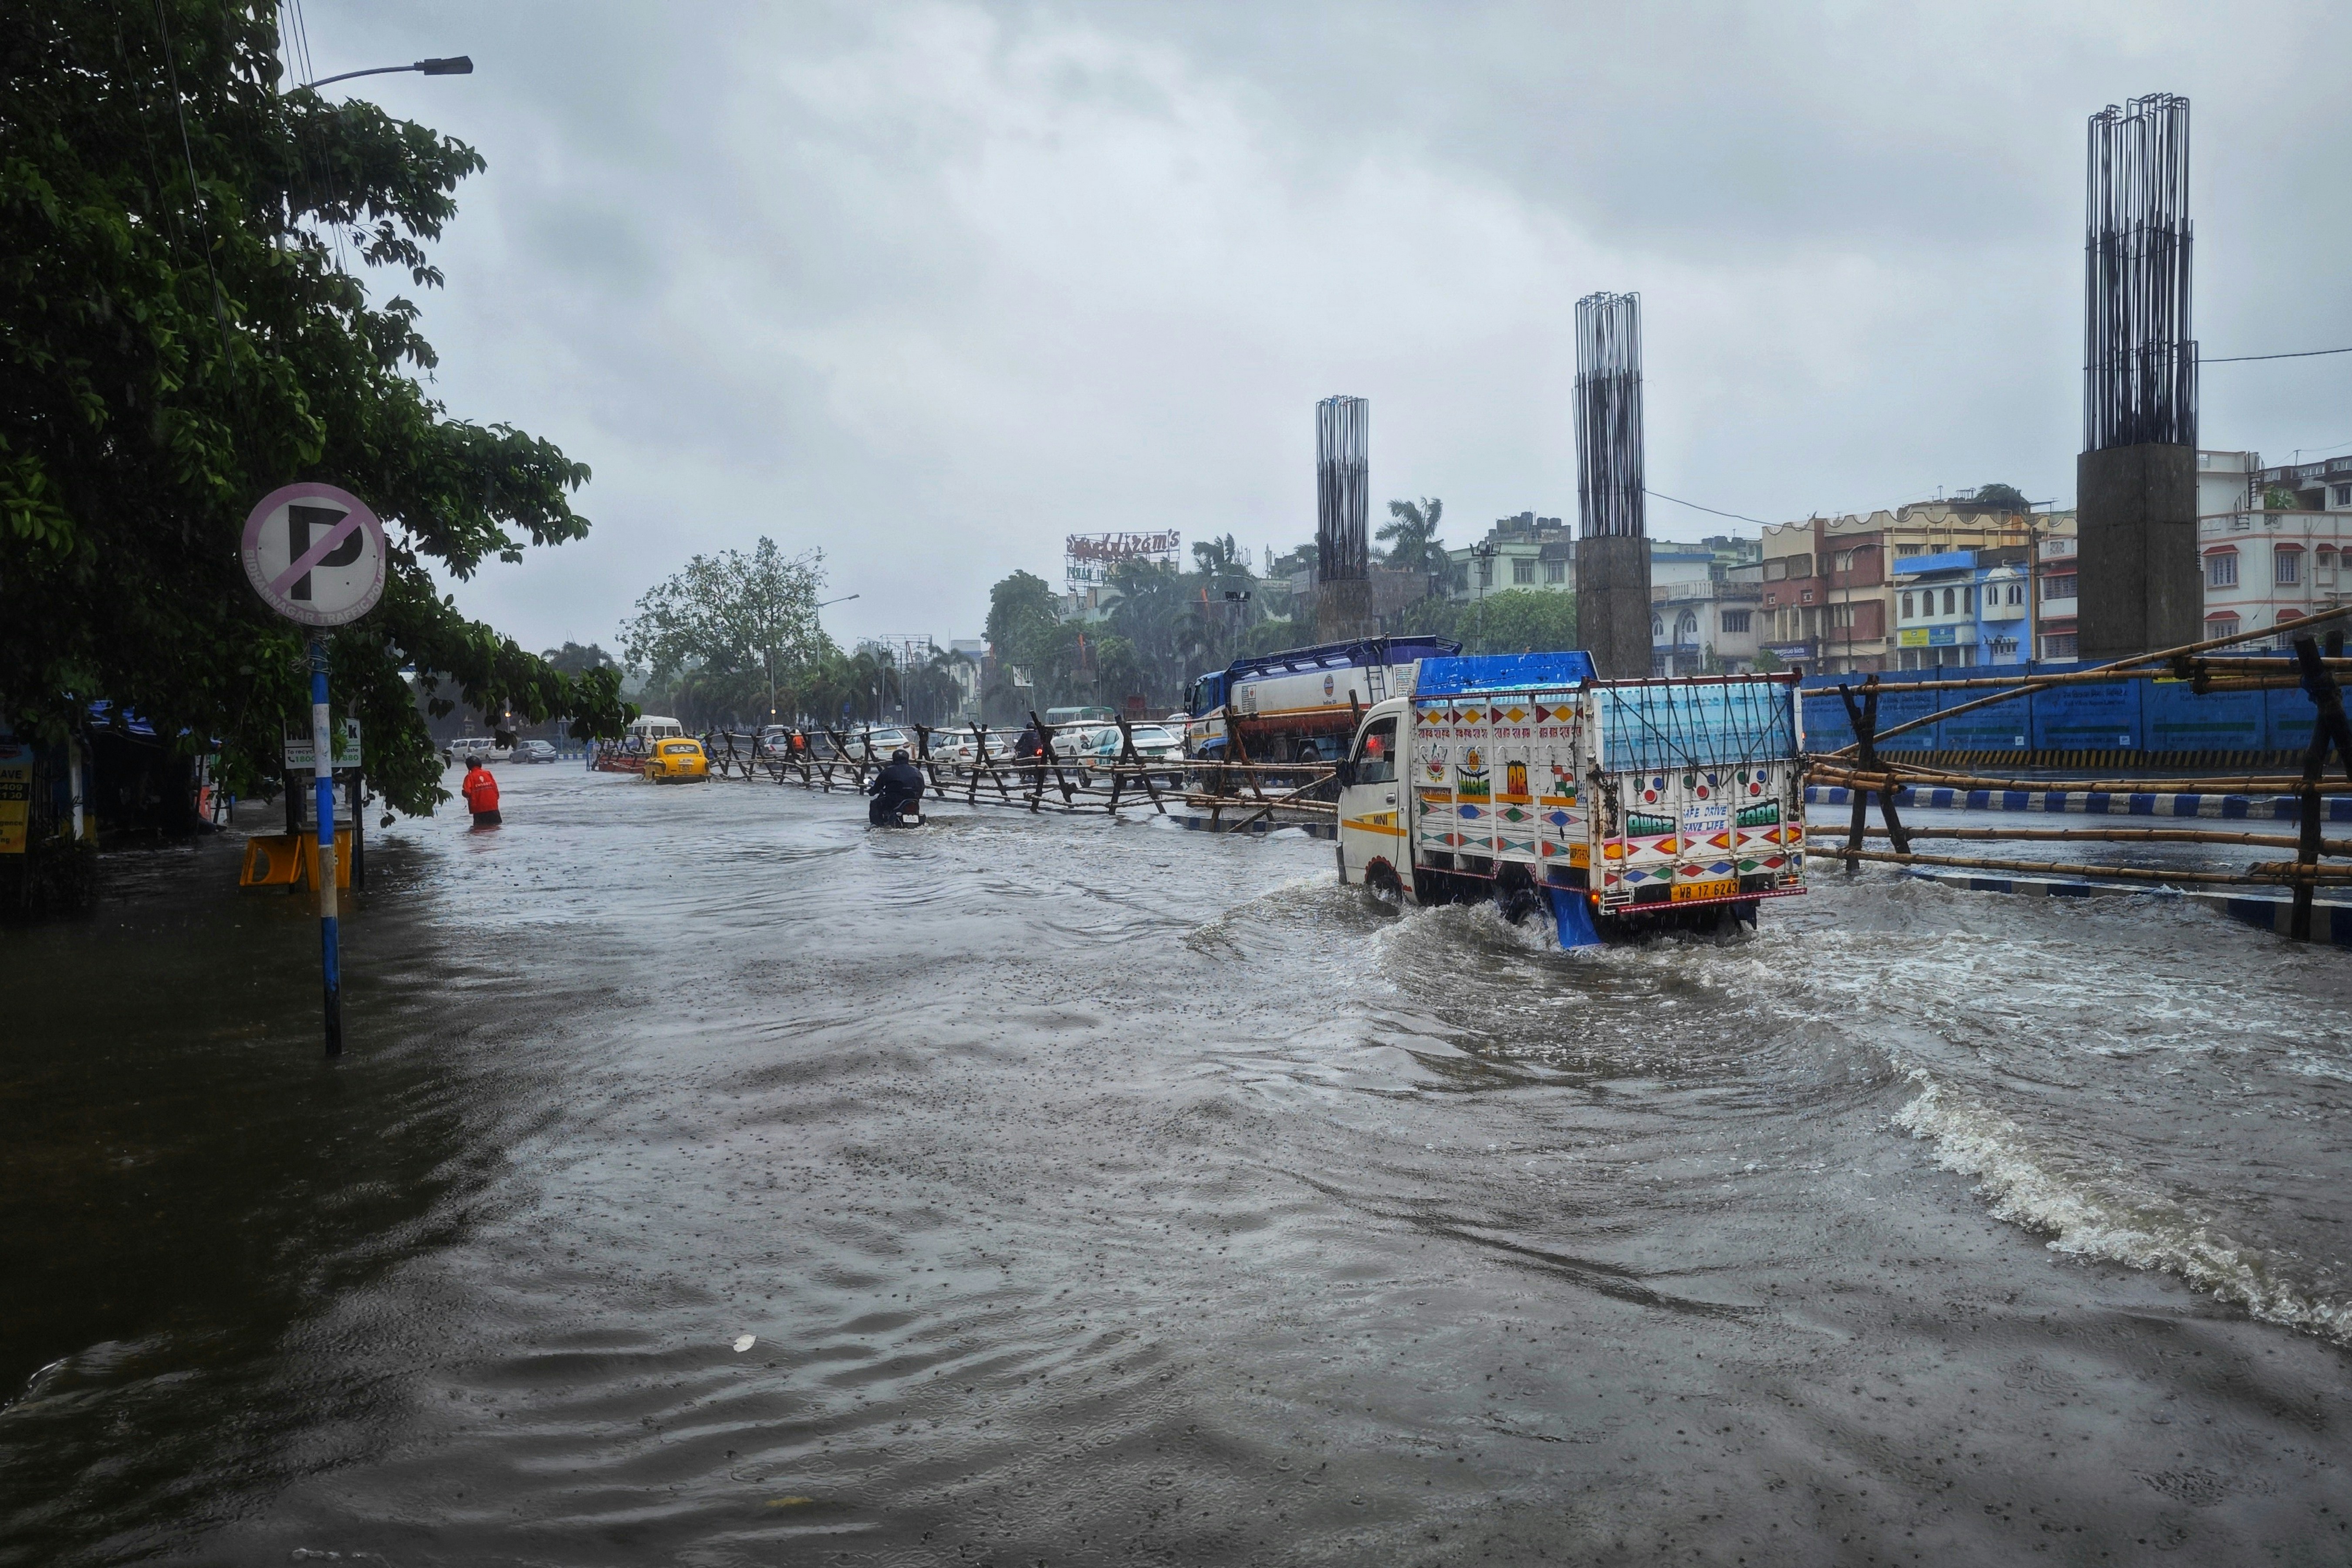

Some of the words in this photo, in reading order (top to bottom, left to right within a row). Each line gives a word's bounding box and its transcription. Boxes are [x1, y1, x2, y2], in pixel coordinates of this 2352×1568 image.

[288, 504, 363, 601] P
[244, 549, 315, 623] BIDHANNAGAR
[318, 601, 370, 624] TRAFFIC
[368, 559, 386, 604] POLICE
[1704, 806, 1727, 817] DRIVE
[1373, 814, 1388, 826] MINI
[1683, 822, 1703, 832] SAVE
[1707, 820, 1725, 831] LIFE
[1680, 886, 1691, 899] WB
[1698, 885, 1709, 897] 17
[1714, 882, 1738, 896] 6243
